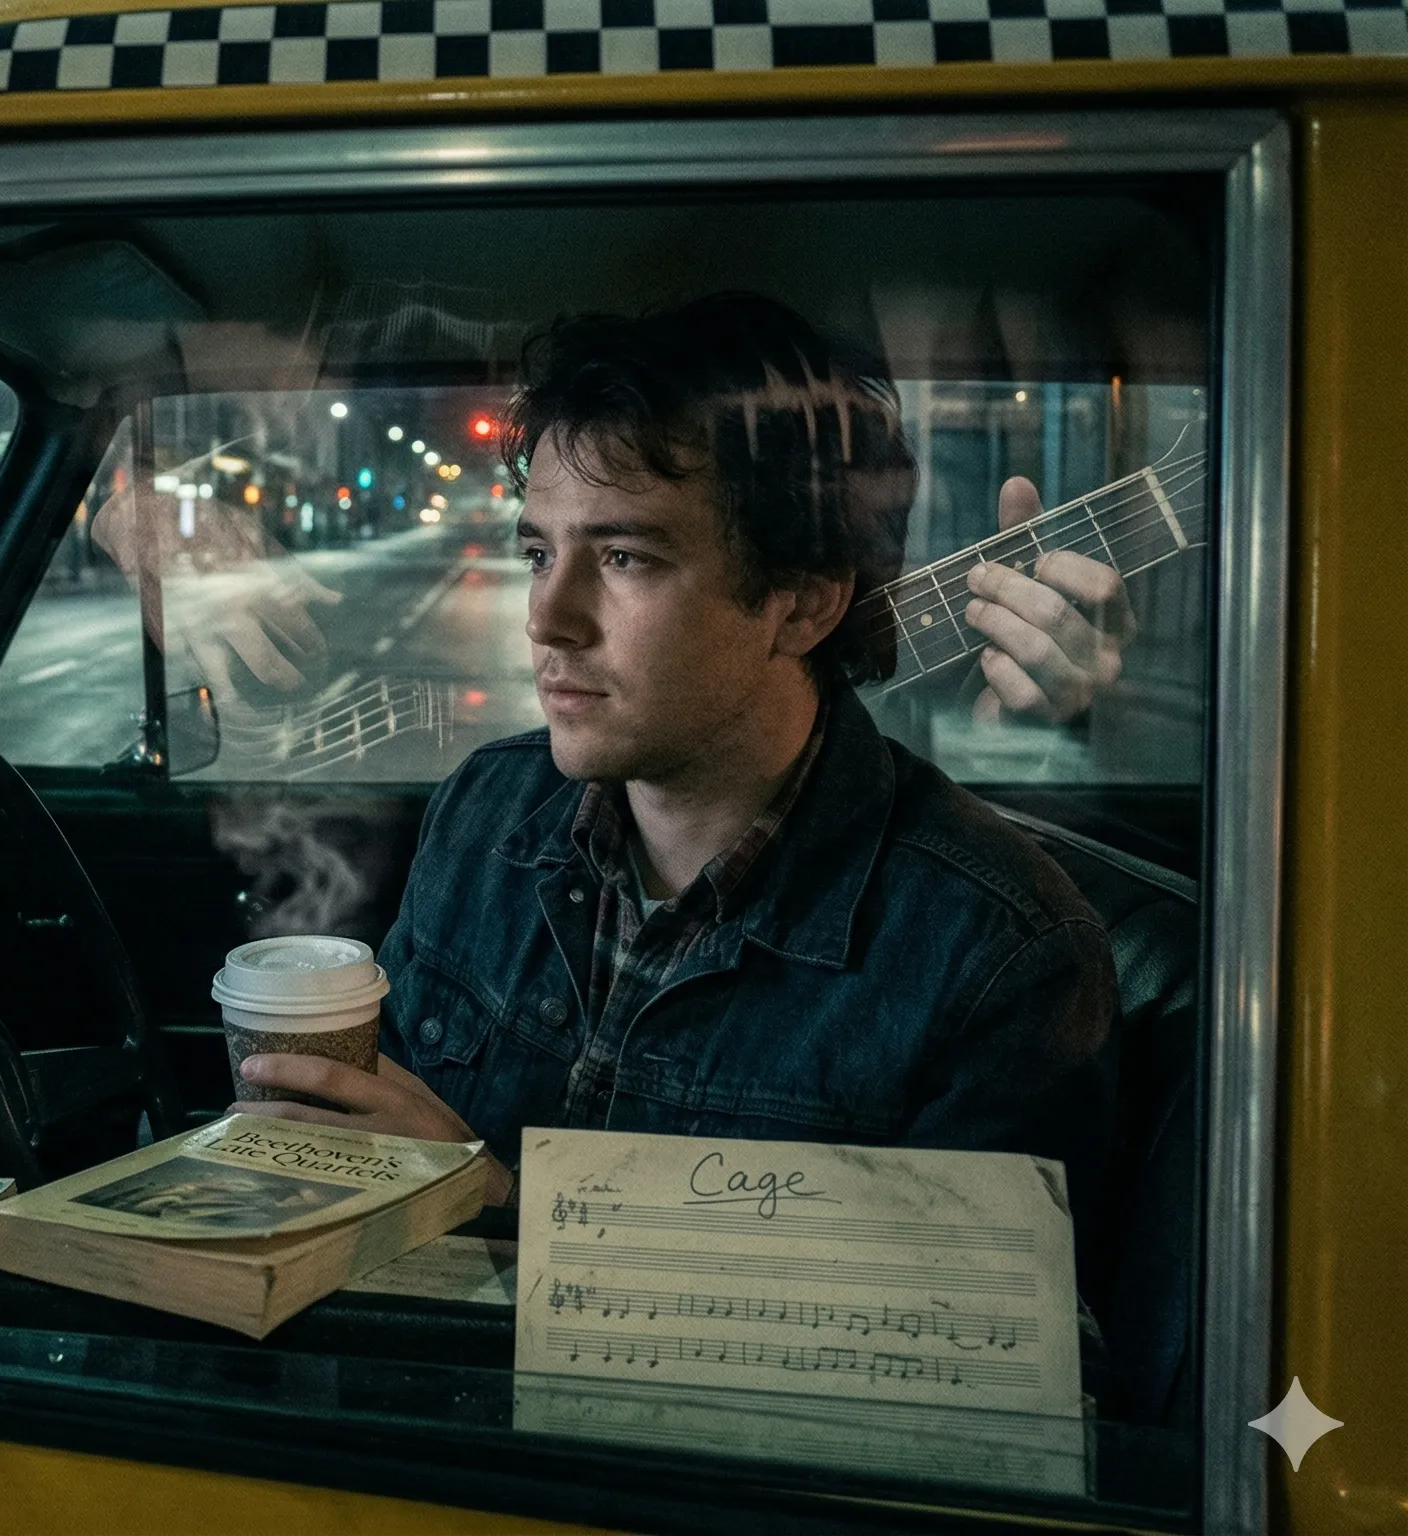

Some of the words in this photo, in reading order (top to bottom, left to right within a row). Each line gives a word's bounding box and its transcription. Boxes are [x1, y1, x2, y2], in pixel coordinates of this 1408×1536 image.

[203, 1137, 263, 1160] Late
[272, 1151, 401, 1182] Quartets
[231, 1131, 403, 1170] Beethoven's
[689, 1152, 827, 1220] Cage
